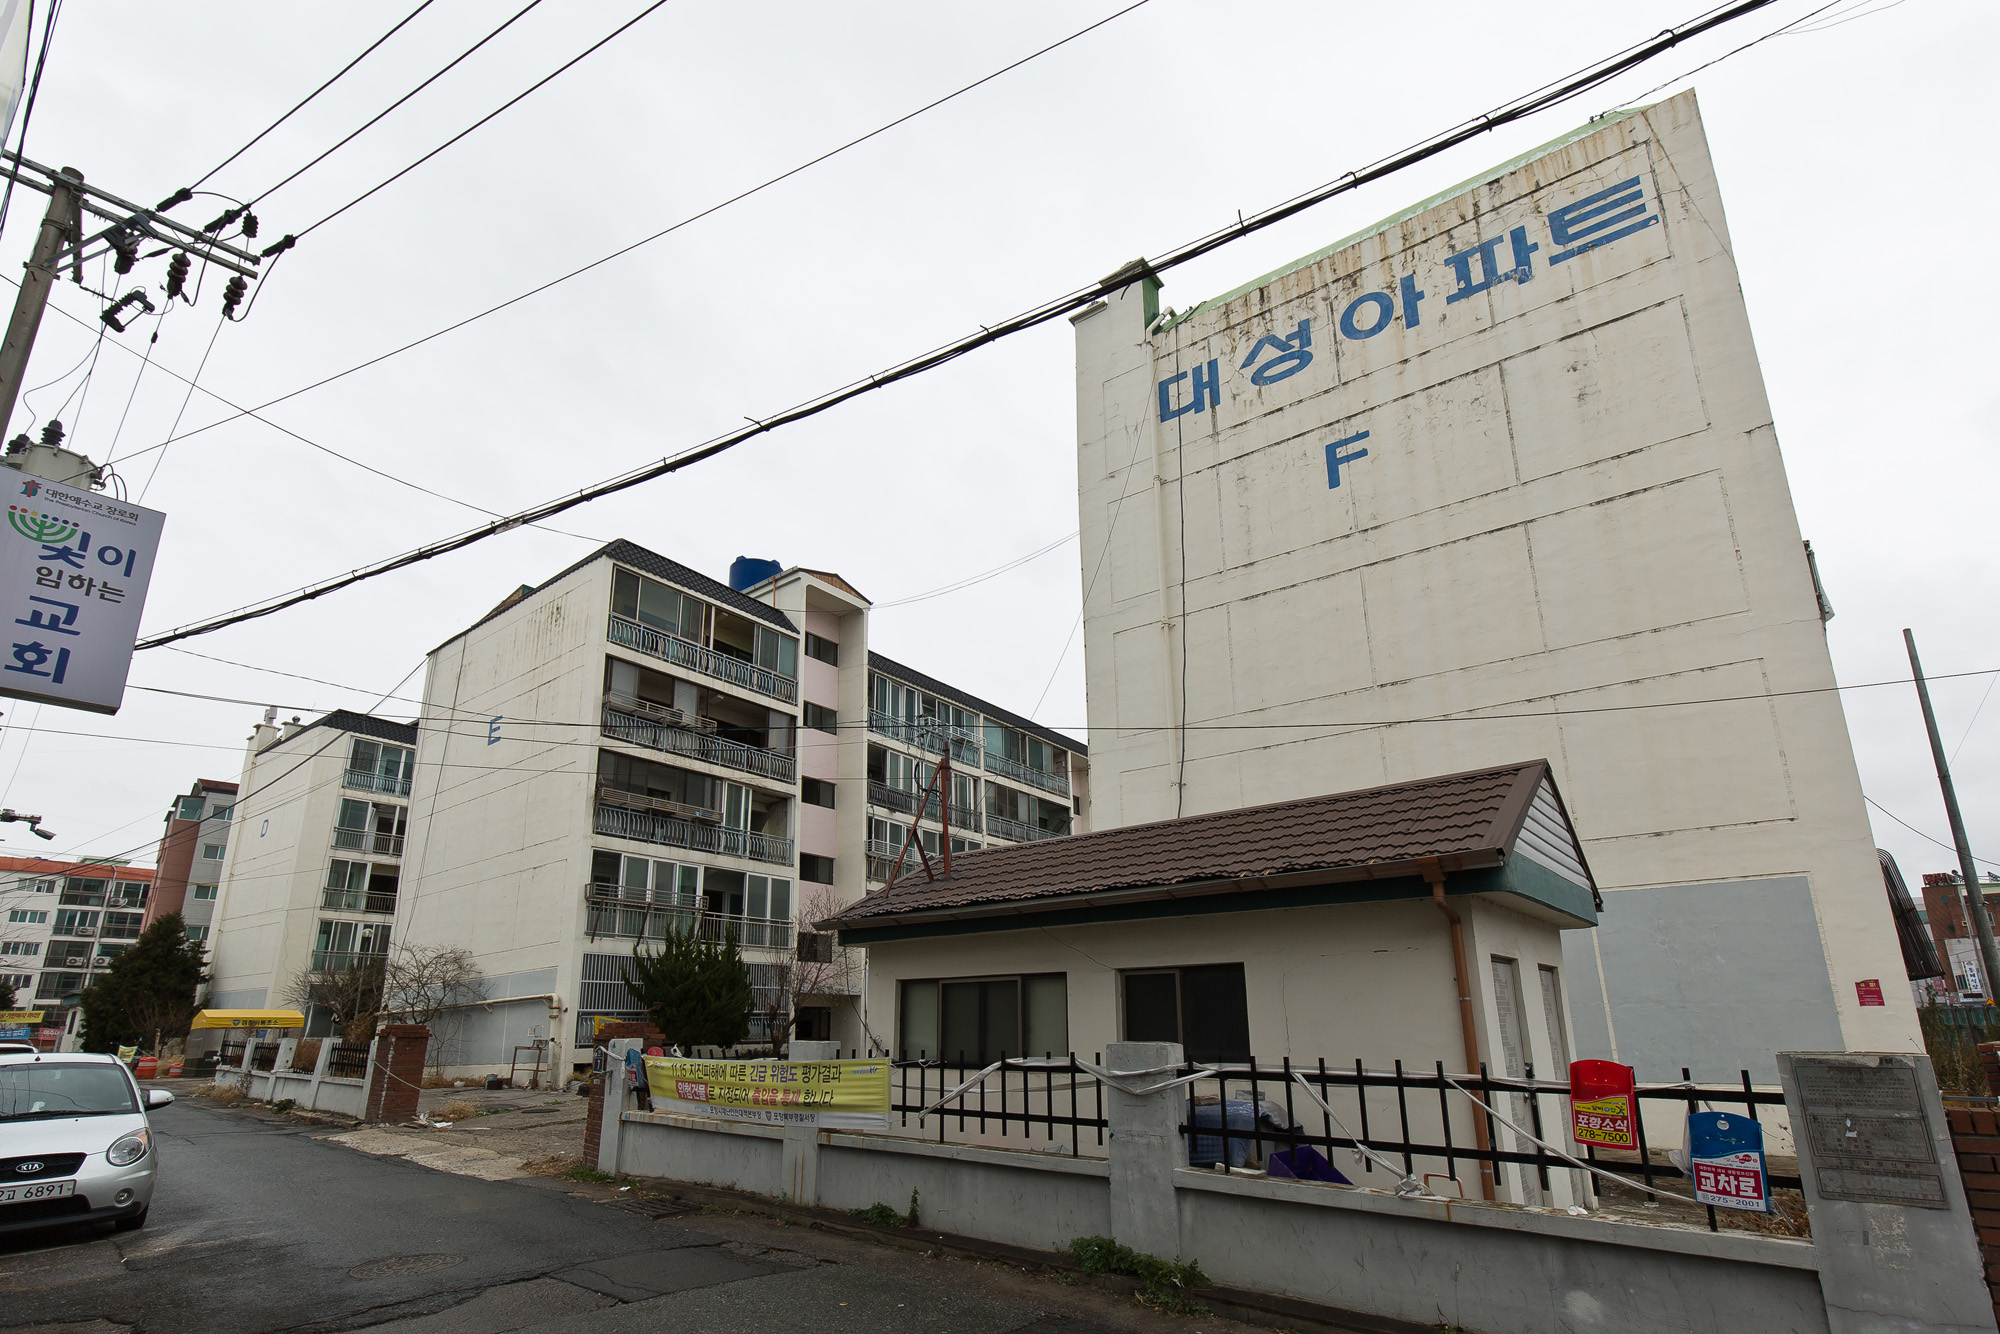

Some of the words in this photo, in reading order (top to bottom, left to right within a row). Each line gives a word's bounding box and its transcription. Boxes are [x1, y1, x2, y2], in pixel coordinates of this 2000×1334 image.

[1158, 175, 1659, 423] 대성아파트
[1325, 429, 1370, 490] F
[45, 488, 102, 511] 대한예수교
[106, 505, 139, 521] 장로회
[55, 499, 90, 514] Presbyterian
[91, 509, 112, 520] Church
[120, 517, 136, 526] Korea
[35, 566, 125, 604] 임하는
[487, 715, 503, 746] E
[260, 819, 269, 838] D
[671, 1062, 687, 1078] 11.15
[689, 1062, 727, 1081] 지진피해에
[729, 1064, 747, 1082] 따른
[749, 1064, 768, 1082] 긴급
[770, 1064, 798, 1083] 위험도
[801, 1064, 842, 1084] 평가결과
[718, 1086, 750, 1104] 지정되어
[751, 1087, 779, 1107] 출입을
[780, 1088, 801, 1107] 통제
[803, 1089, 834, 1108] 합니다
[1577, 1114, 1628, 1132] 포항소식
[1578, 1128, 1628, 1143] 278-7500
[24, 1184, 64, 1199] 6891
[1700, 1171, 1758, 1198] 교차로
[1710, 1195, 1760, 1208] 275-2001
